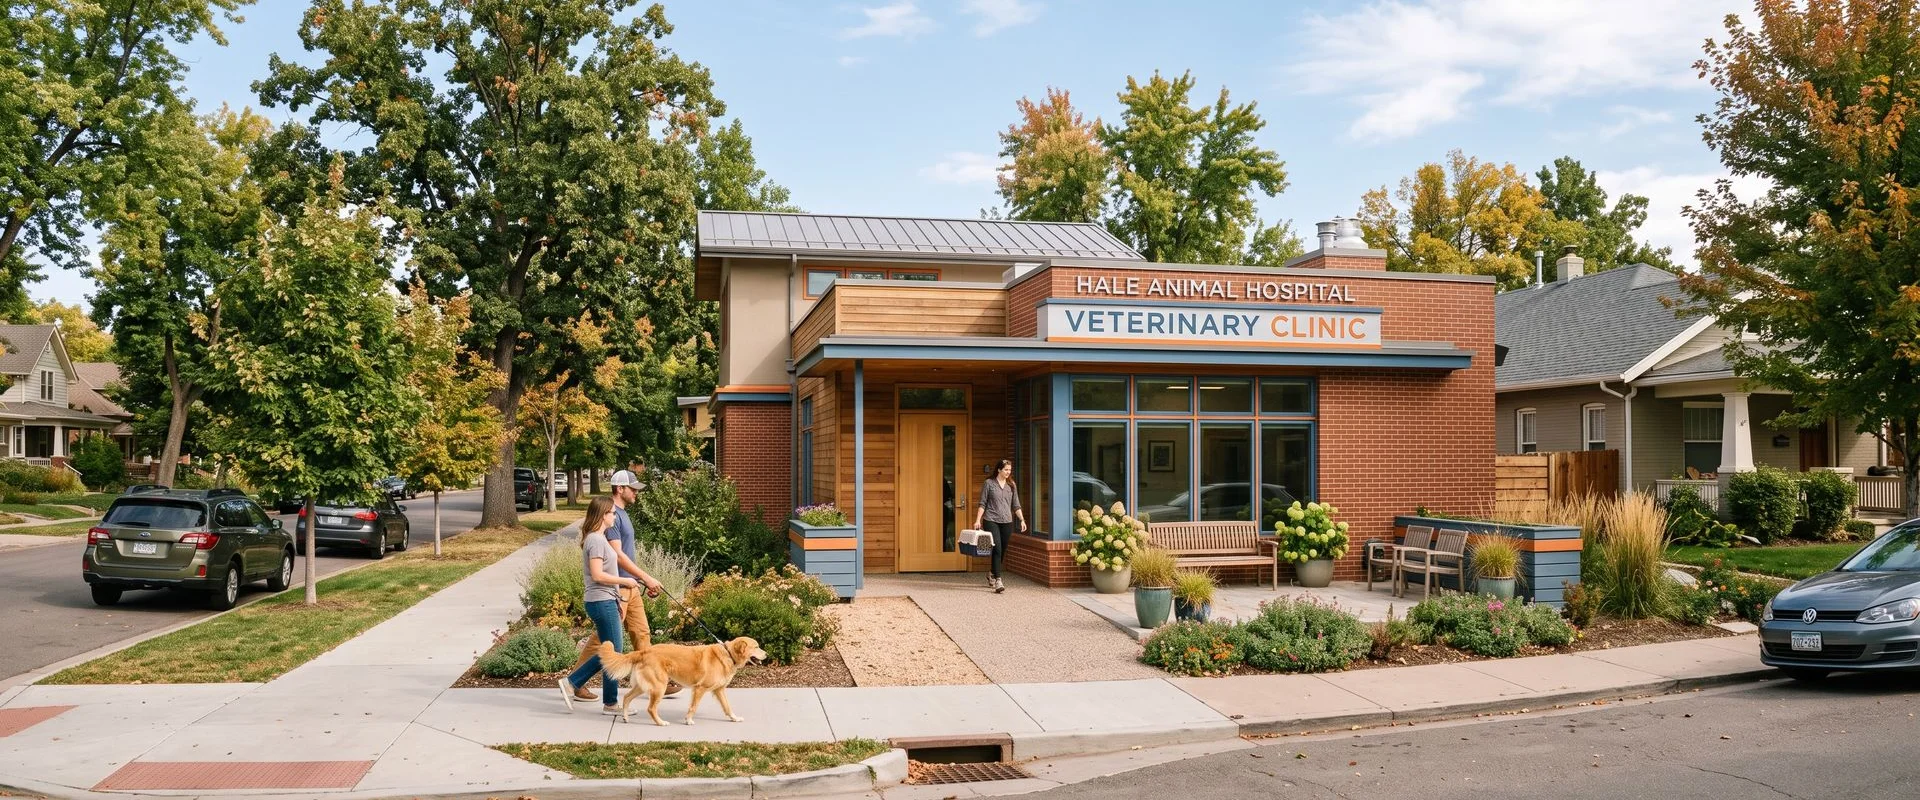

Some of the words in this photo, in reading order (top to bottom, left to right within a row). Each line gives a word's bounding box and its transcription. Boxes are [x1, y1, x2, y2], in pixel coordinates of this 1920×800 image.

[1077, 275, 1139, 296] HALE
[1147, 277, 1238, 299] ANIMAL
[1245, 281, 1356, 302] HOSPITAL
[1065, 309, 1259, 337] VETERINARY
[1270, 315, 1366, 340] CLINIC
[1803, 608, 1817, 624] VW
